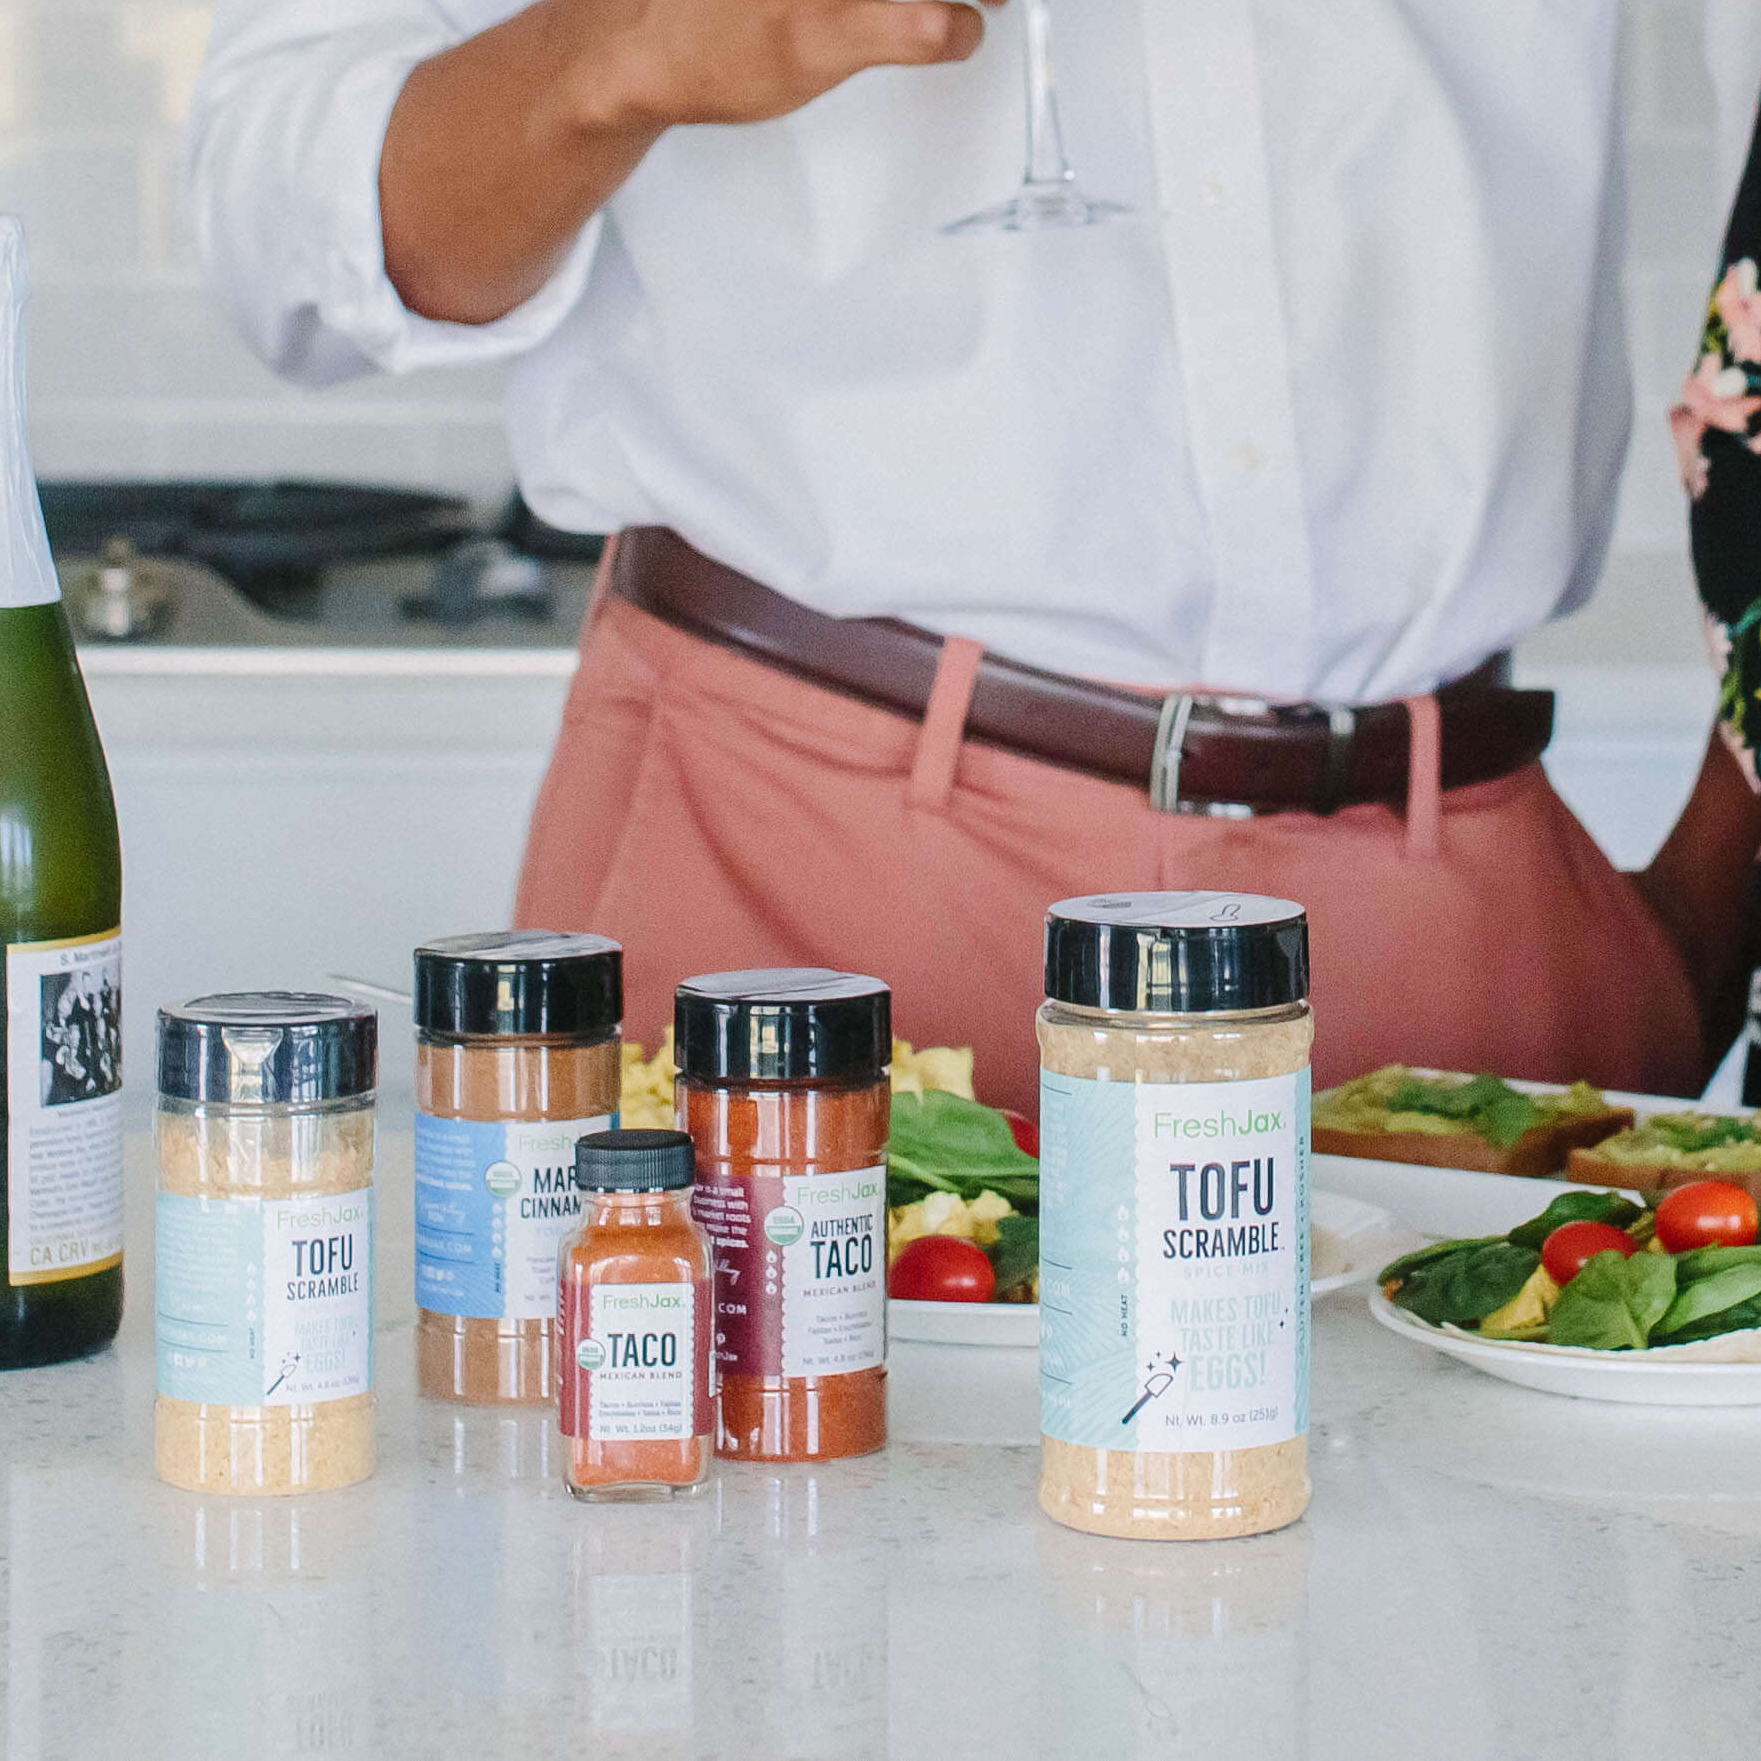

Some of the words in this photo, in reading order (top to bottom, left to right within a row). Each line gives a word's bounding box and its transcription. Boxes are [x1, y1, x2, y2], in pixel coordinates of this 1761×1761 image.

[1154, 1109, 1281, 1139] FreshJax
[797, 1182, 878, 1205] FreshJax
[1169, 1157, 1274, 1221] TOFU
[277, 1205, 360, 1230] FreshJax
[811, 1214, 873, 1239] AUTHENTIC
[1163, 1222, 1279, 1259] SCRAMBLE
[30, 1246, 52, 1266] CA
[291, 1234, 353, 1277] TOFU
[810, 1234, 873, 1279] TACO
[1183, 1264, 1231, 1279] SPICE
[1242, 1261, 1269, 1275] MIX
[286, 1272, 359, 1301] SCRAMBLE
[802, 1286, 849, 1298] MEXICAN
[852, 1280, 877, 1293] BLEND
[603, 1293, 681, 1310] FreshJax
[1121, 1294, 1129, 1319] HEAT
[1170, 1296, 1238, 1325] MAKES
[1245, 1290, 1280, 1317] TOFU
[1121, 1321, 1129, 1338] NO
[1180, 1325, 1235, 1353] TASTE
[1242, 1322, 1274, 1348] LIKE
[608, 1332, 677, 1368] TACO
[599, 1372, 646, 1380] MEXICAN
[650, 1371, 683, 1379] BLEND
[1189, 1352, 1266, 1391] EGGS!
[1187, 1413, 1206, 1426] Wt.
[1210, 1412, 1229, 1425] 8.9
[1232, 1414, 1246, 1424] oz
